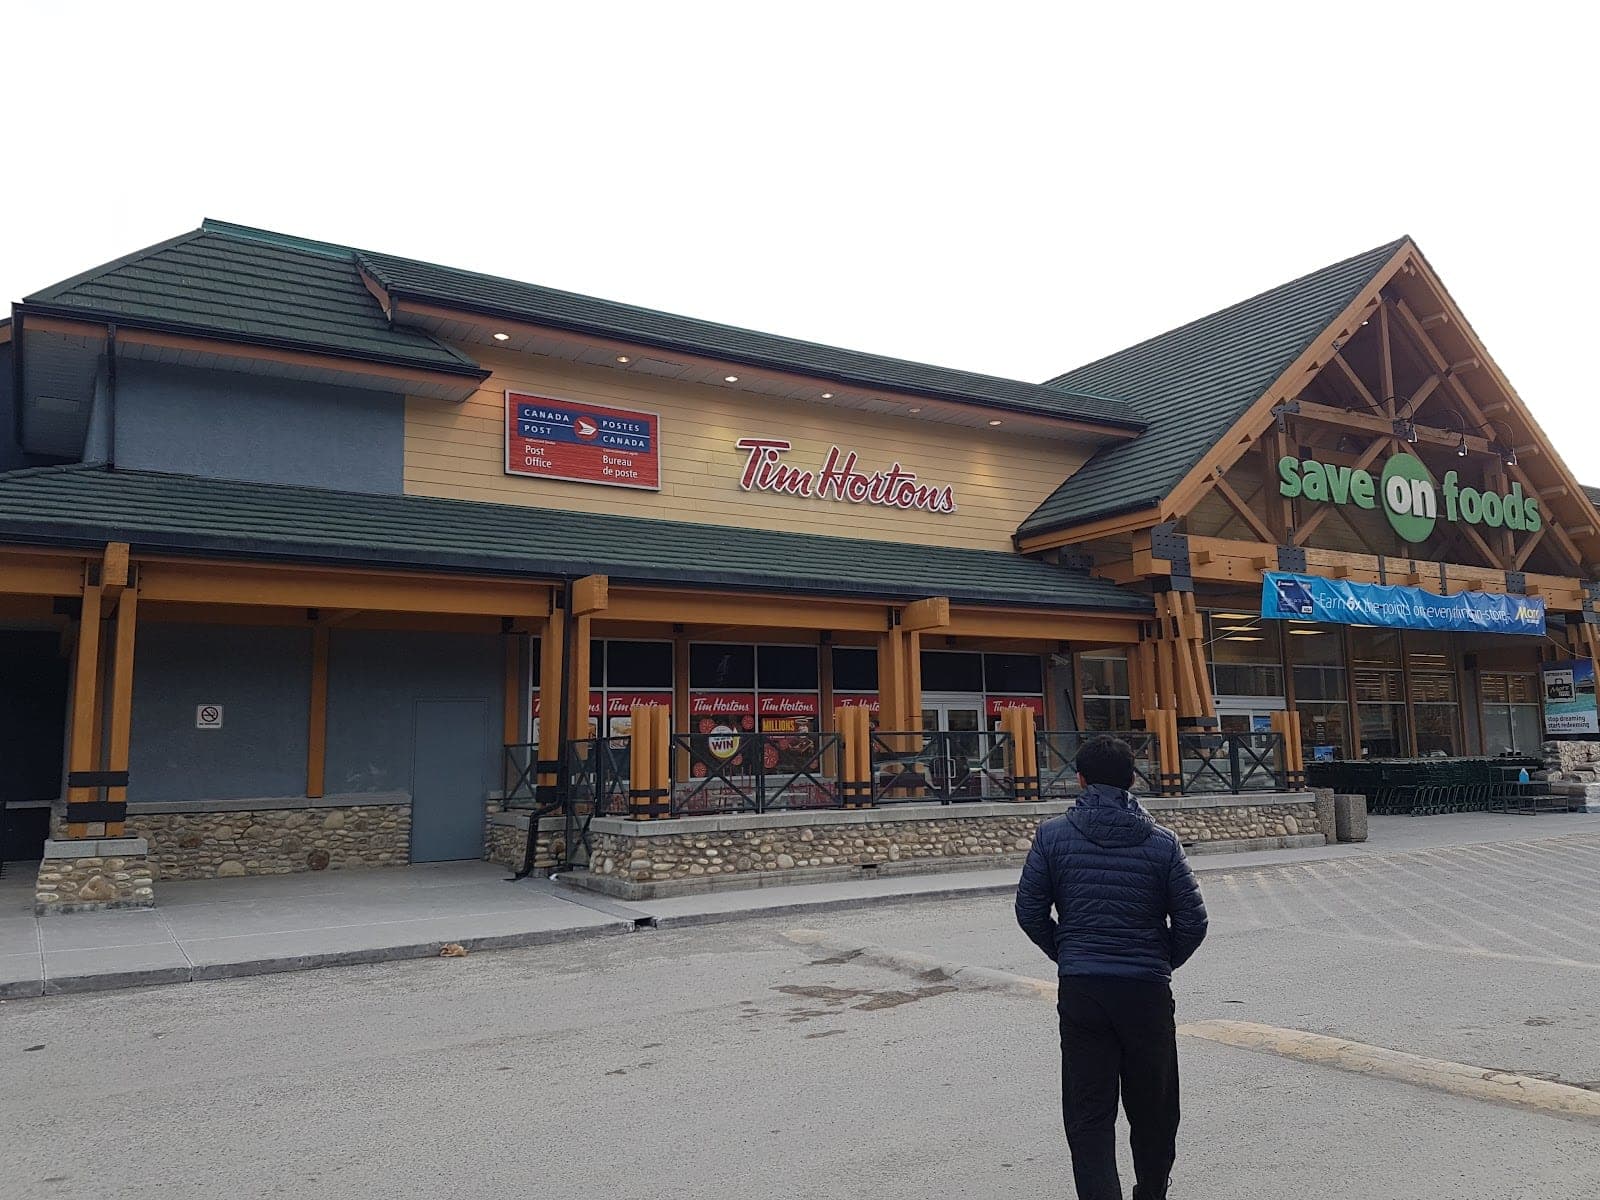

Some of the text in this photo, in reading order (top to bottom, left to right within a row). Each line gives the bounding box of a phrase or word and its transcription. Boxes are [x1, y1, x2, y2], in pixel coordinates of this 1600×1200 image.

[524, 408, 570, 422] CANADA
[524, 424, 551, 435] POST
[603, 420, 640, 432] POSTES
[603, 435, 645, 448] CANADA
[525, 444, 545, 456] Post
[525, 456, 552, 469] Office
[603, 455, 632, 467] Bureau
[603, 466, 638, 479] de poste
[736, 438, 955, 513] Tim Hortons
[1278, 456, 1542, 532] save on foods
[1320, 592, 1345, 609] Earn
[1383, 600, 1410, 616] points
[608, 697, 629, 712] Tim
[693, 697, 749, 712] Tim Hortons
[761, 698, 814, 712] Tim Hortons
[762, 719, 795, 732] MILLIONS
[711, 740, 734, 752] WIN
